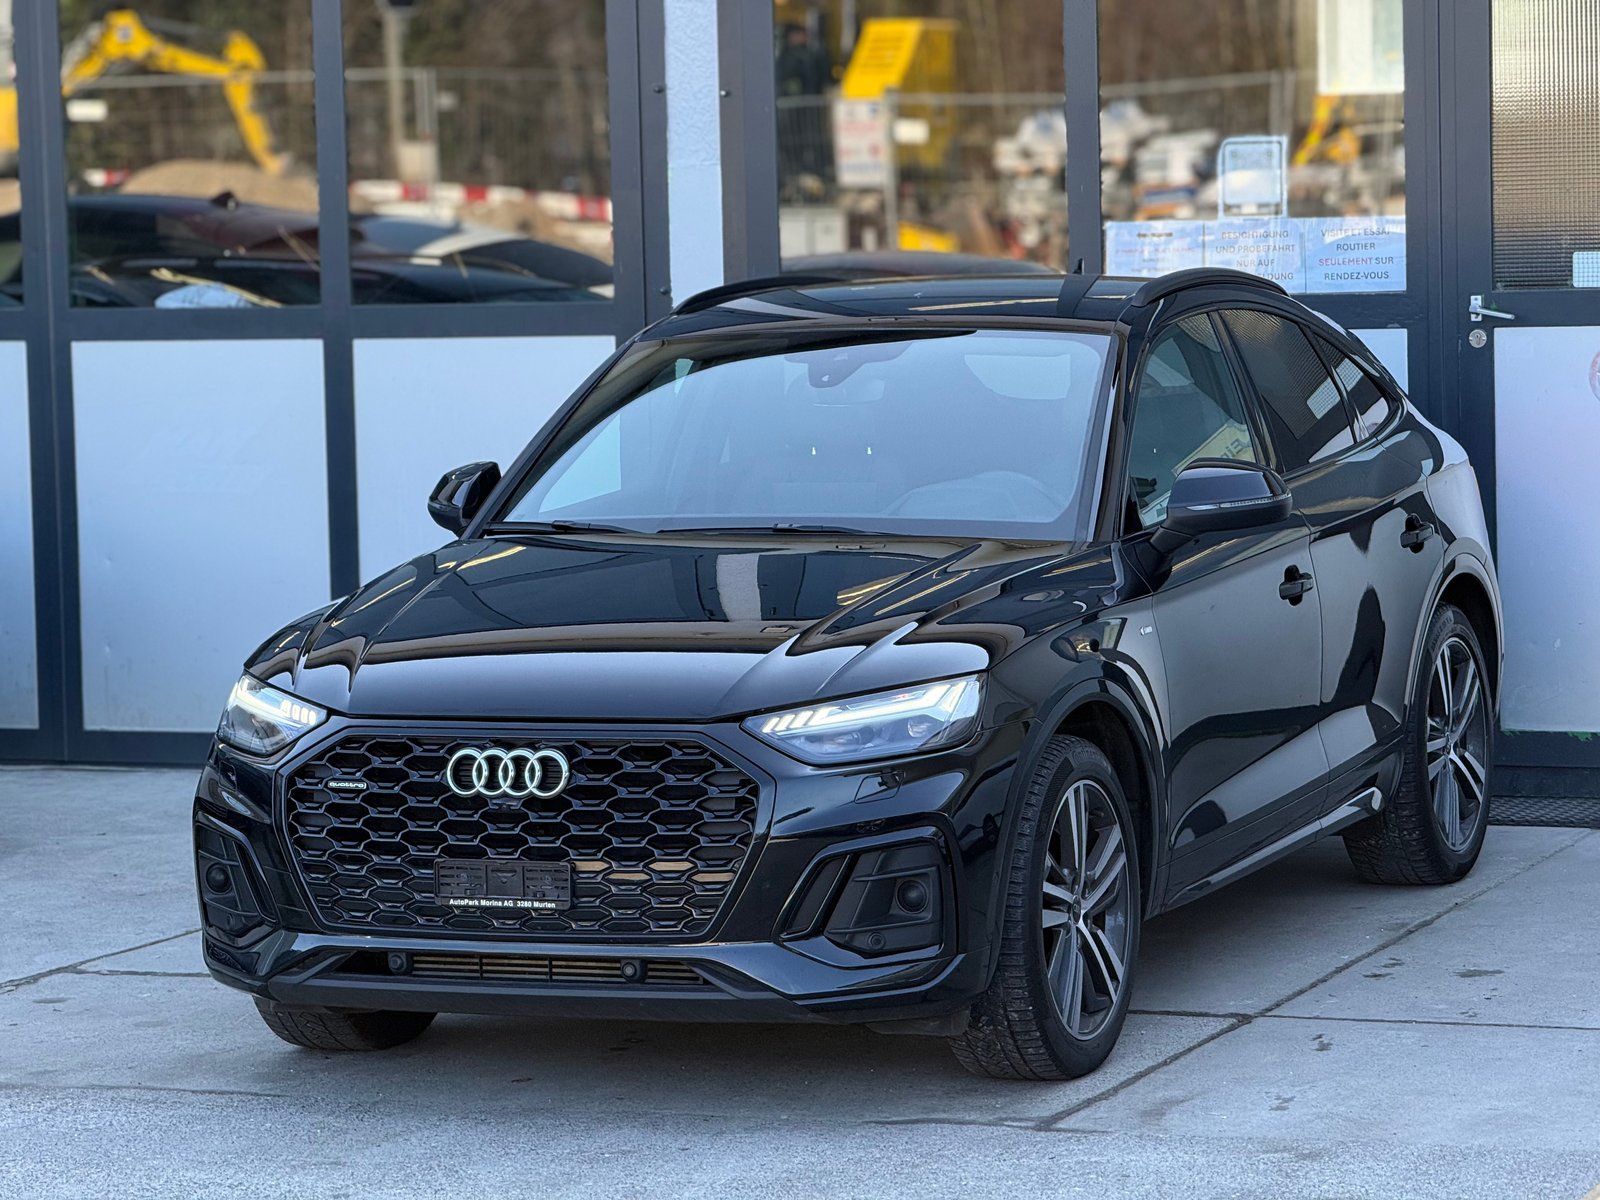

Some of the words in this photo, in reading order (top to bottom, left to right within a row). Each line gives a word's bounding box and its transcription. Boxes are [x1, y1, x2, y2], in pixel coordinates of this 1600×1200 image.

[1221, 230, 1289, 240] BESICHTIGUNG
[1215, 245, 1236, 254] UND
[1237, 244, 1296, 254] PROBEFAHRT
[1336, 242, 1376, 252] ROUTIER
[1236, 259, 1256, 268] NUR
[1257, 258, 1275, 267] AUF
[1318, 257, 1373, 267] SEULEMENT
[1374, 256, 1394, 265] SUR
[1324, 271, 1390, 281] RENDEZ-VOUS
[329, 781, 365, 789] quattro
[449, 898, 479, 906] AutoPark
[480, 899, 502, 907] Morina
[516, 900, 532, 908] 3280
[533, 901, 556, 909] Murten
